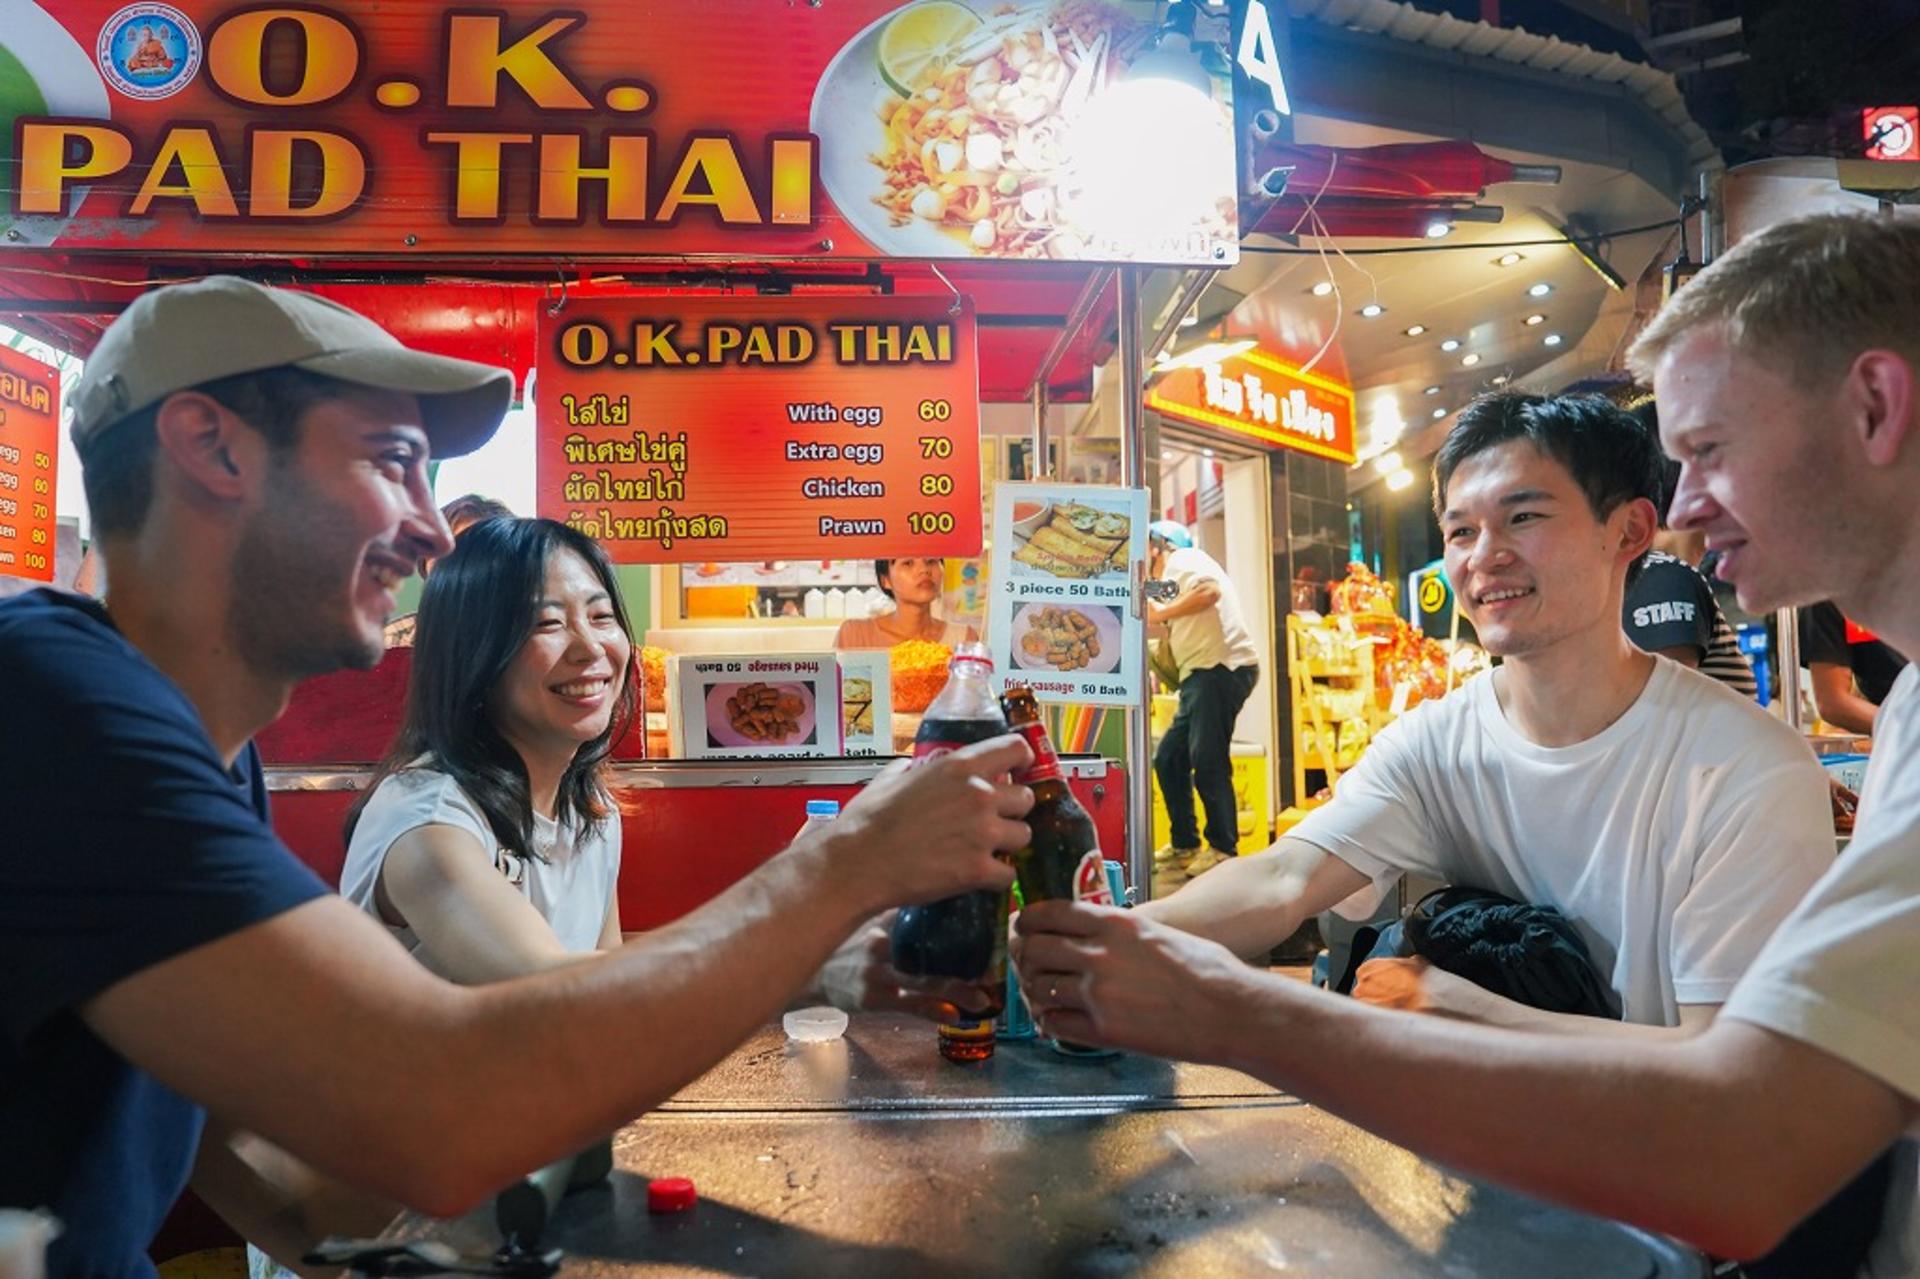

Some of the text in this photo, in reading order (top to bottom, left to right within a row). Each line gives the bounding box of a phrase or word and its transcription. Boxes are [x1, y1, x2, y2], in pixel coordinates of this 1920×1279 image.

[206, 8, 651, 112] O.K.
[18, 122, 812, 225] PAD THAI
[830, 324, 951, 362] THAI
[562, 395, 628, 425] ใส่ไข่
[788, 401, 950, 426] With egg 60
[564, 432, 686, 472] พิเศษไข่คู่
[786, 438, 951, 464] Extra egg 70
[564, 470, 685, 501] ผัดไทยไก่
[803, 475, 953, 497] Chicken 80
[33, 503, 48, 519] 70
[32, 528, 46, 544] 80
[820, 513, 954, 535] Prawn 100
[25, 552, 46, 569] 100
[1005, 581, 1131, 598] 3 piece 50 Bath
[1632, 601, 1695, 627] STAFF
[695, 660, 819, 673] fried sausage 50 Bath
[1030, 681, 1075, 694] sausage
[1081, 684, 1097, 694] 50
[1099, 686, 1128, 696] Bath
